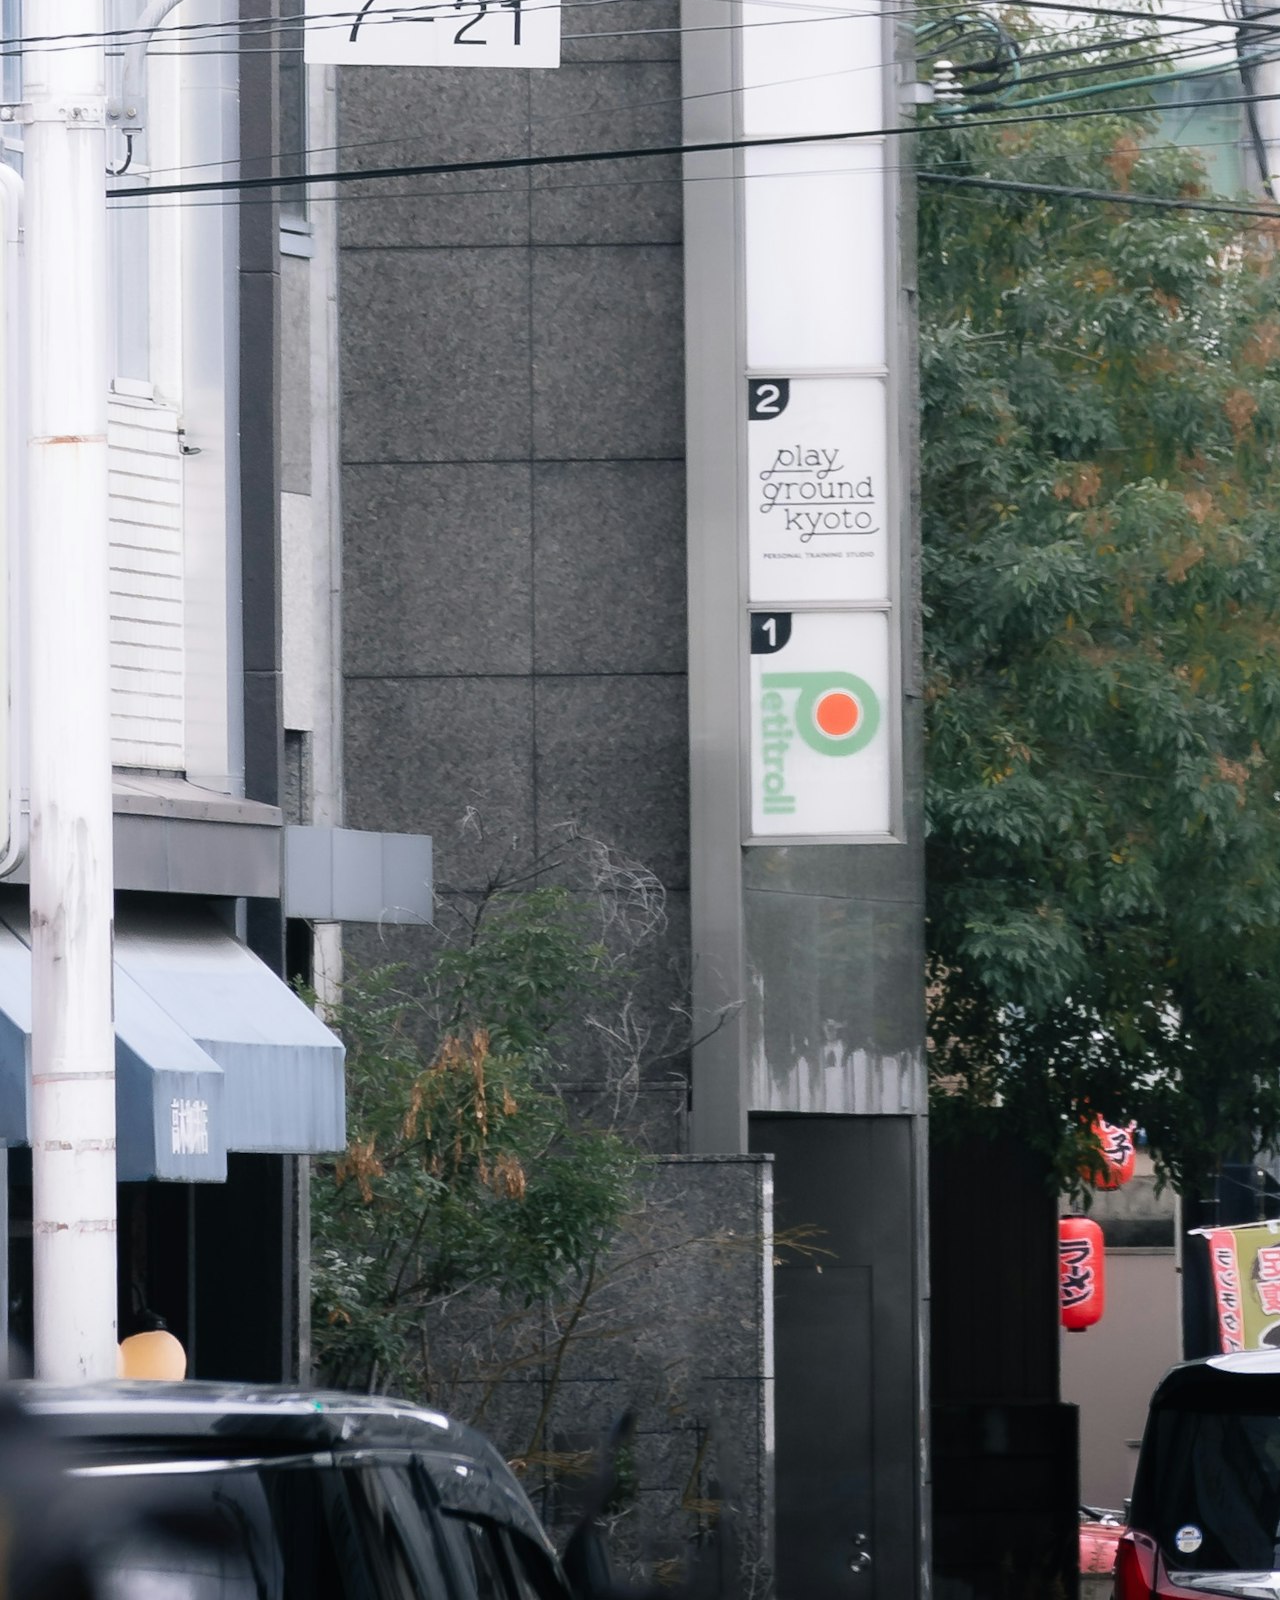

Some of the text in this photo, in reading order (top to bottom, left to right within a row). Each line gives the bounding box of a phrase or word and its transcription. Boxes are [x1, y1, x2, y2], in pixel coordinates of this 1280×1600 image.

[756, 384, 780, 413] 2
[760, 444, 844, 480] play
[760, 476, 875, 513] ground
[784, 508, 880, 543] kyoto
[762, 618, 776, 646] 1
[1060, 1239, 1092, 1308] ラーメン
